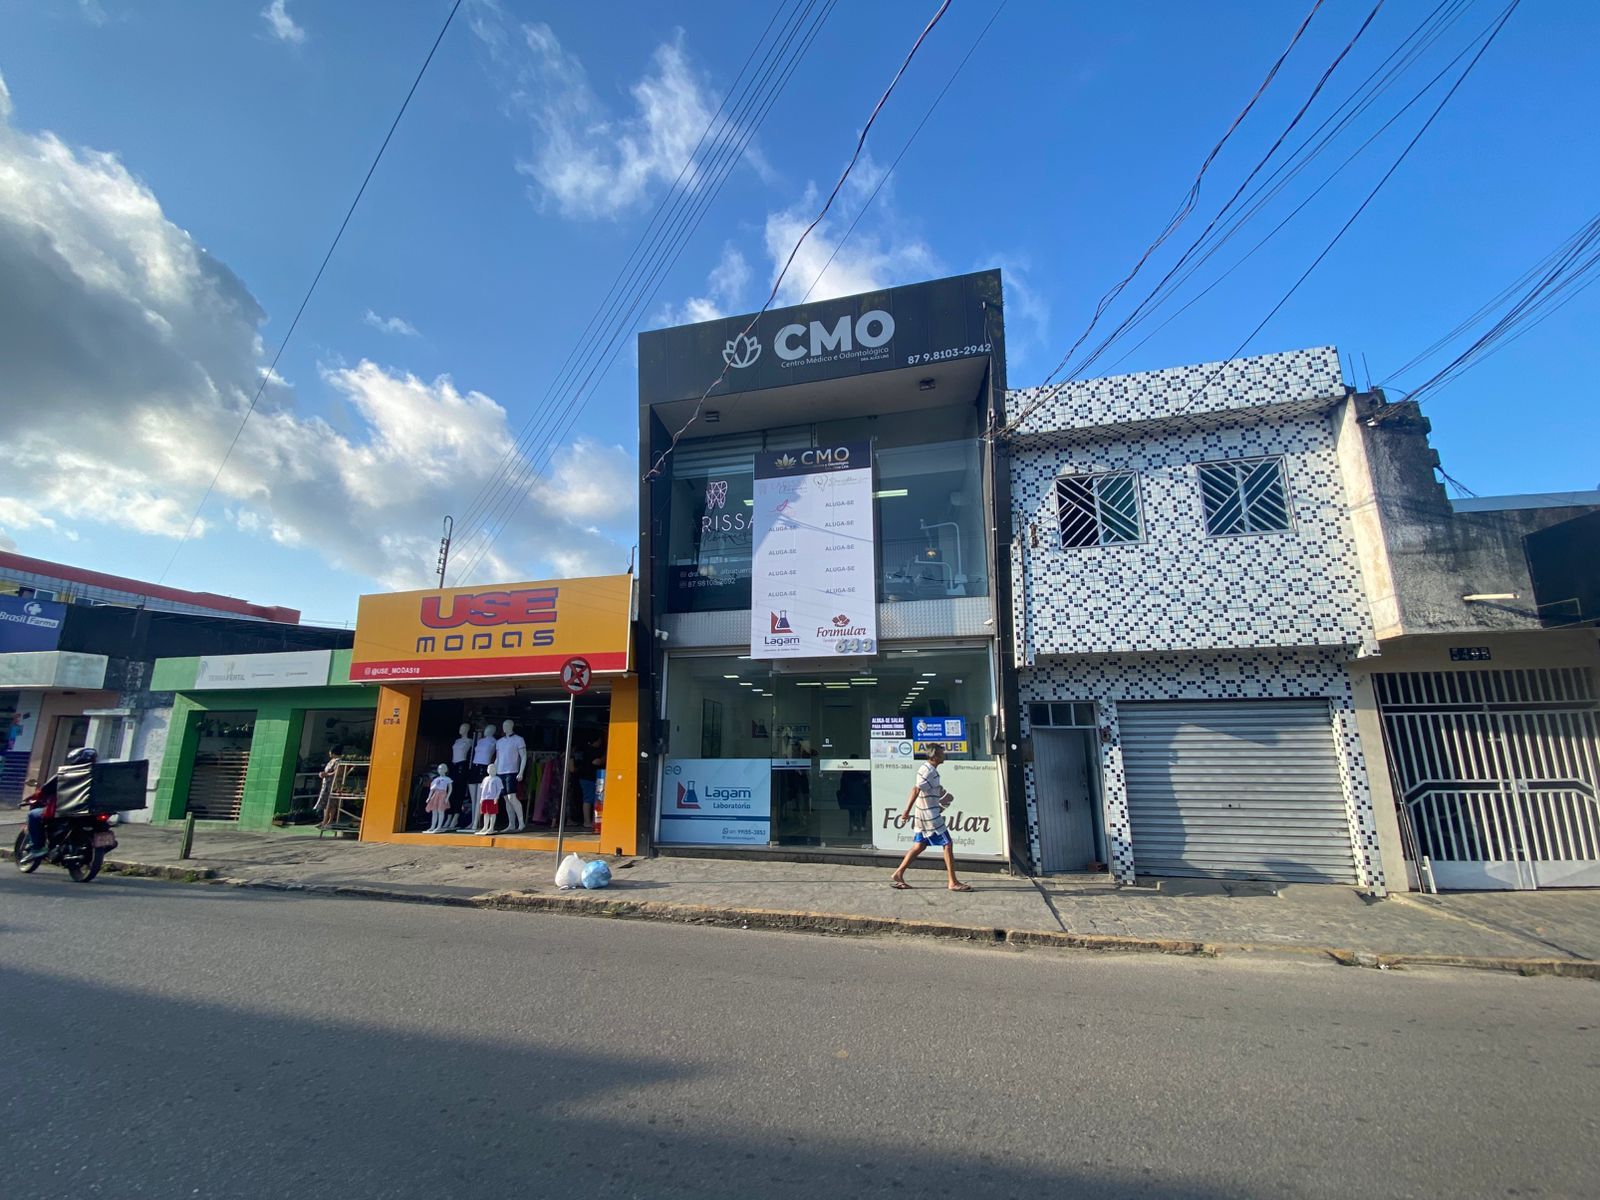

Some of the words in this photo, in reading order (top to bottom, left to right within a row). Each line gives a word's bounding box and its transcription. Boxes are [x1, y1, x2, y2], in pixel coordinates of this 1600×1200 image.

[774, 310, 895, 360] CMO
[781, 359, 805, 368] Centro
[806, 355, 832, 364] Médico
[839, 347, 889, 359] Odontológico
[907, 355, 920, 364] 87
[923, 343, 991, 361] 9.8103-2942
[801, 447, 849, 465] CMO
[825, 520, 854, 528] ALUGA-SE
[825, 544, 855, 552] ALUGA-SE
[768, 569, 797, 577] ALUGA-SE
[825, 565, 855, 573] ALUGA-SE
[420, 587, 559, 629] USE
[816, 626, 866, 638] Formular
[764, 636, 800, 646] Lagam
[835, 638, 873, 653] 643
[705, 786, 751, 801] Lagam
